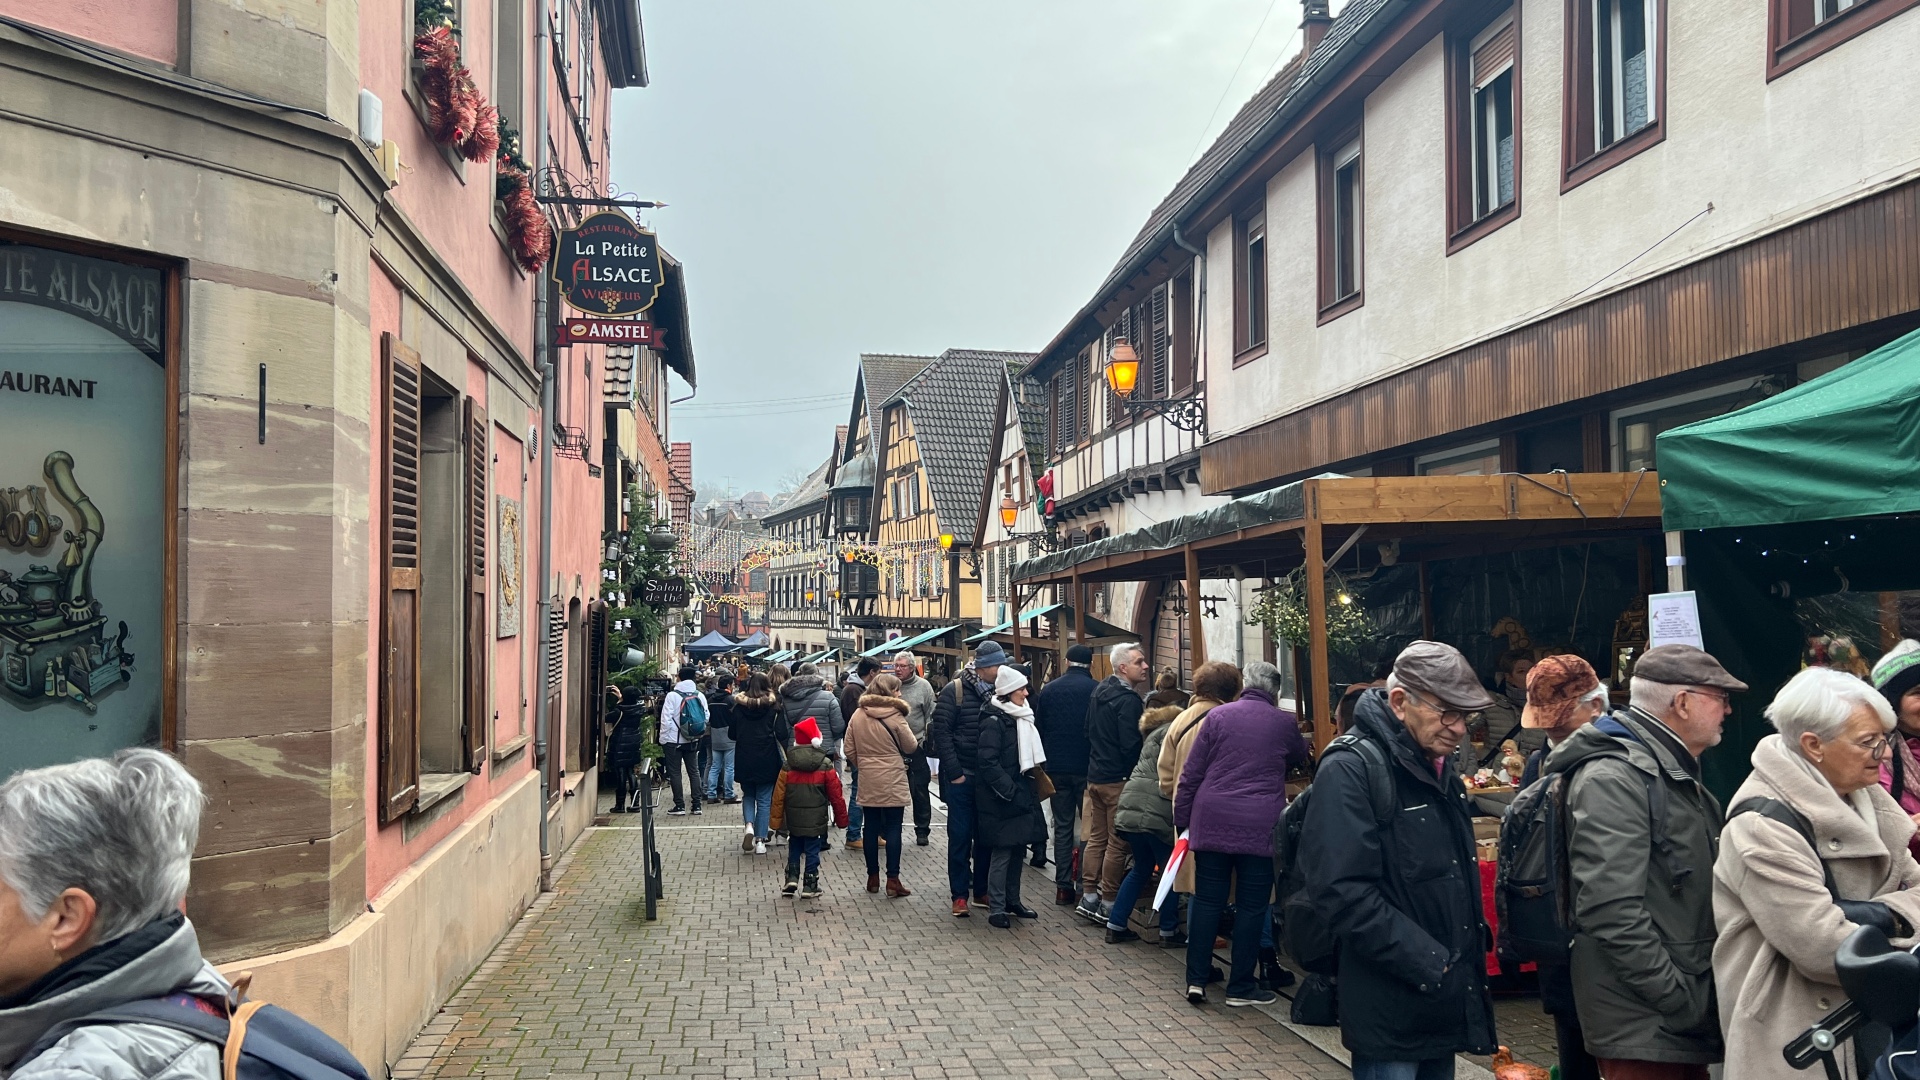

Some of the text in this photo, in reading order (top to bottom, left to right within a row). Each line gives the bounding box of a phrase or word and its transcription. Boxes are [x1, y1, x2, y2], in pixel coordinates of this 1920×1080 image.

[577, 224, 640, 240] RESTAURANT
[575, 240, 647, 258] La Petite
[572, 258, 652, 283] ALSACE
[46, 259, 161, 353] ALSACE
[588, 323, 649, 339] AMSTEL
[0, 371, 98, 399] AURANT
[646, 579, 683, 592] Salon
[645, 593, 683, 603] de thé
